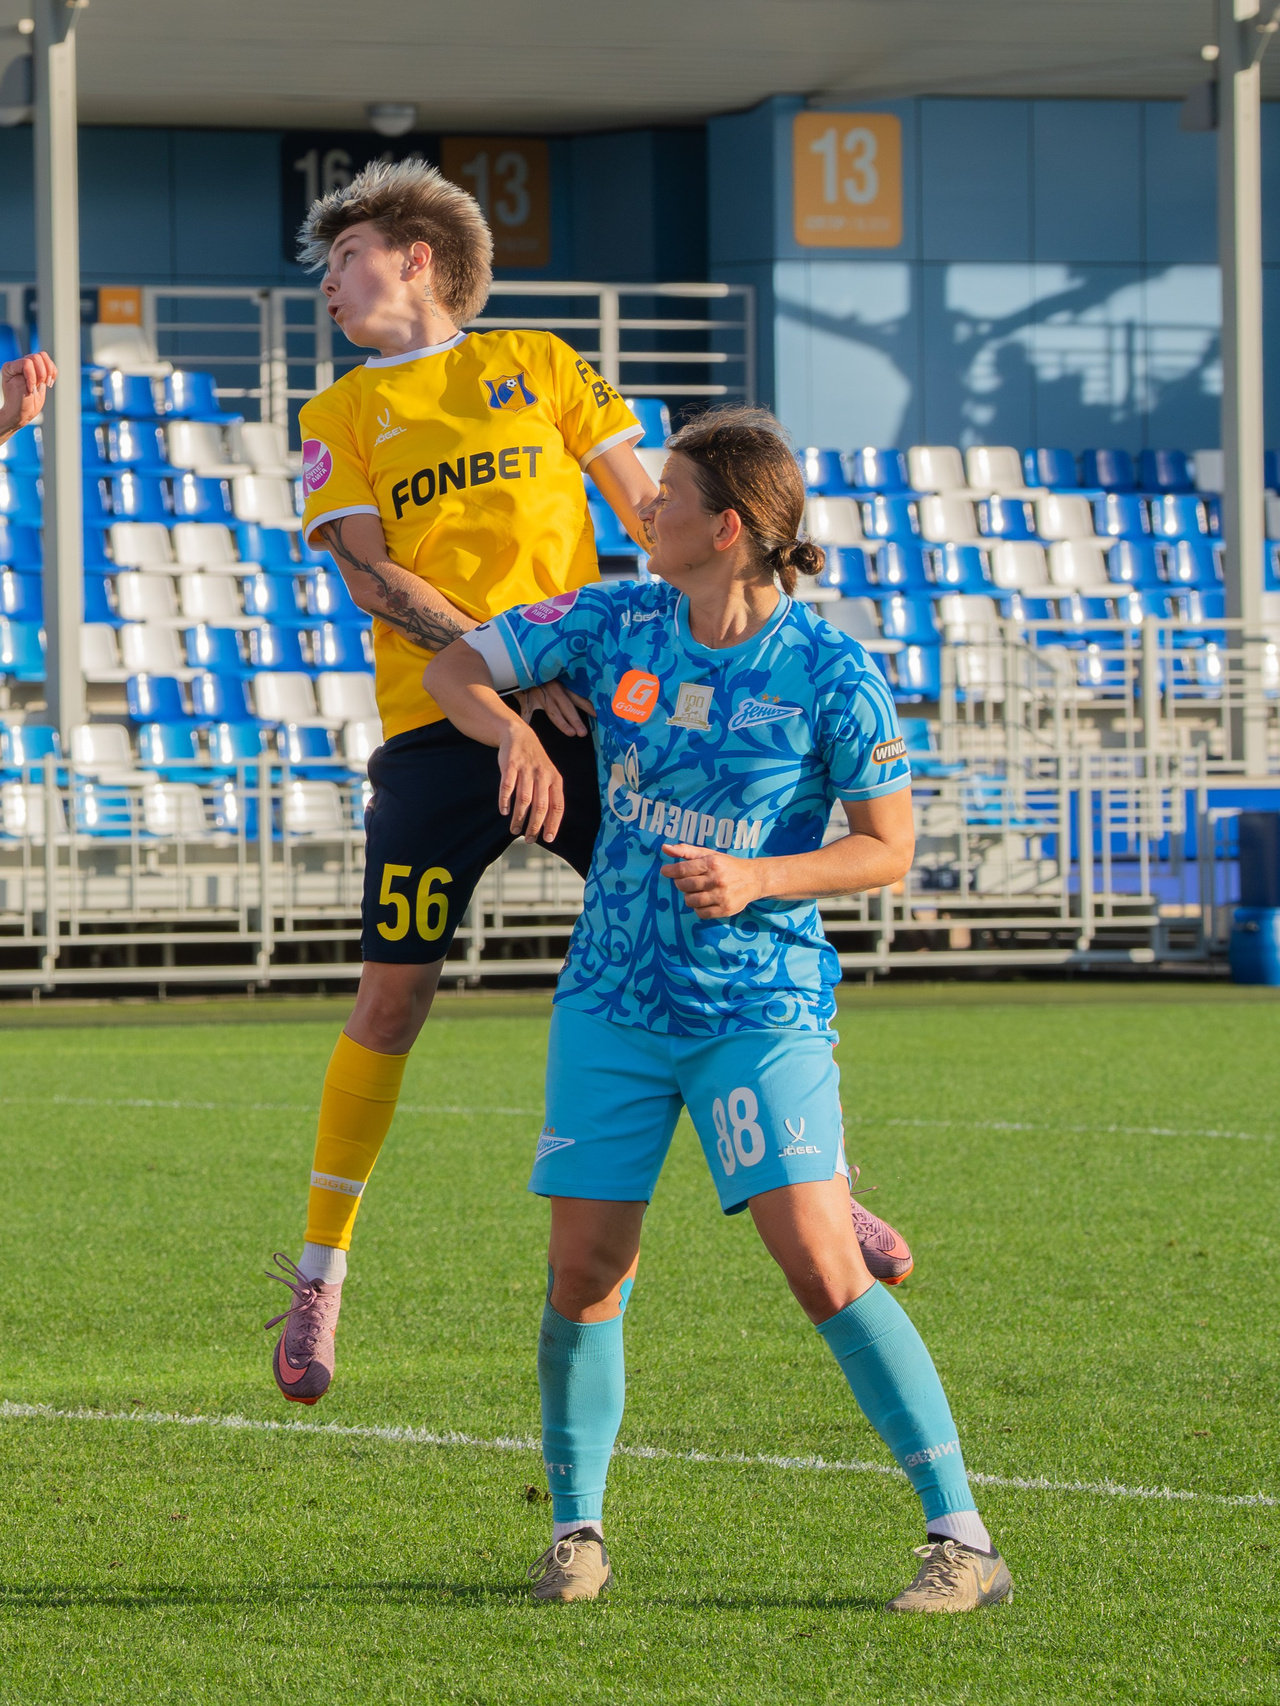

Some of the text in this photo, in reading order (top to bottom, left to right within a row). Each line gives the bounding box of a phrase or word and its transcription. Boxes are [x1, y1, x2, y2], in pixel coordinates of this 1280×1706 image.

[809, 125, 880, 207] 13
[462, 149, 531, 228] 13
[374, 425, 408, 448] JÖGEL
[305, 460, 325, 480] СУПЕР
[311, 467, 328, 484] ЛИГА
[391, 445, 543, 520] FONBET
[530, 608, 548, 621] ЛИГА
[638, 796, 763, 850] ГАЗПРОМ
[376, 862, 454, 942] 56
[712, 1086, 766, 1177] 88
[777, 1144, 822, 1158] JÖGEL
[312, 1175, 357, 1194] JÖGEL
